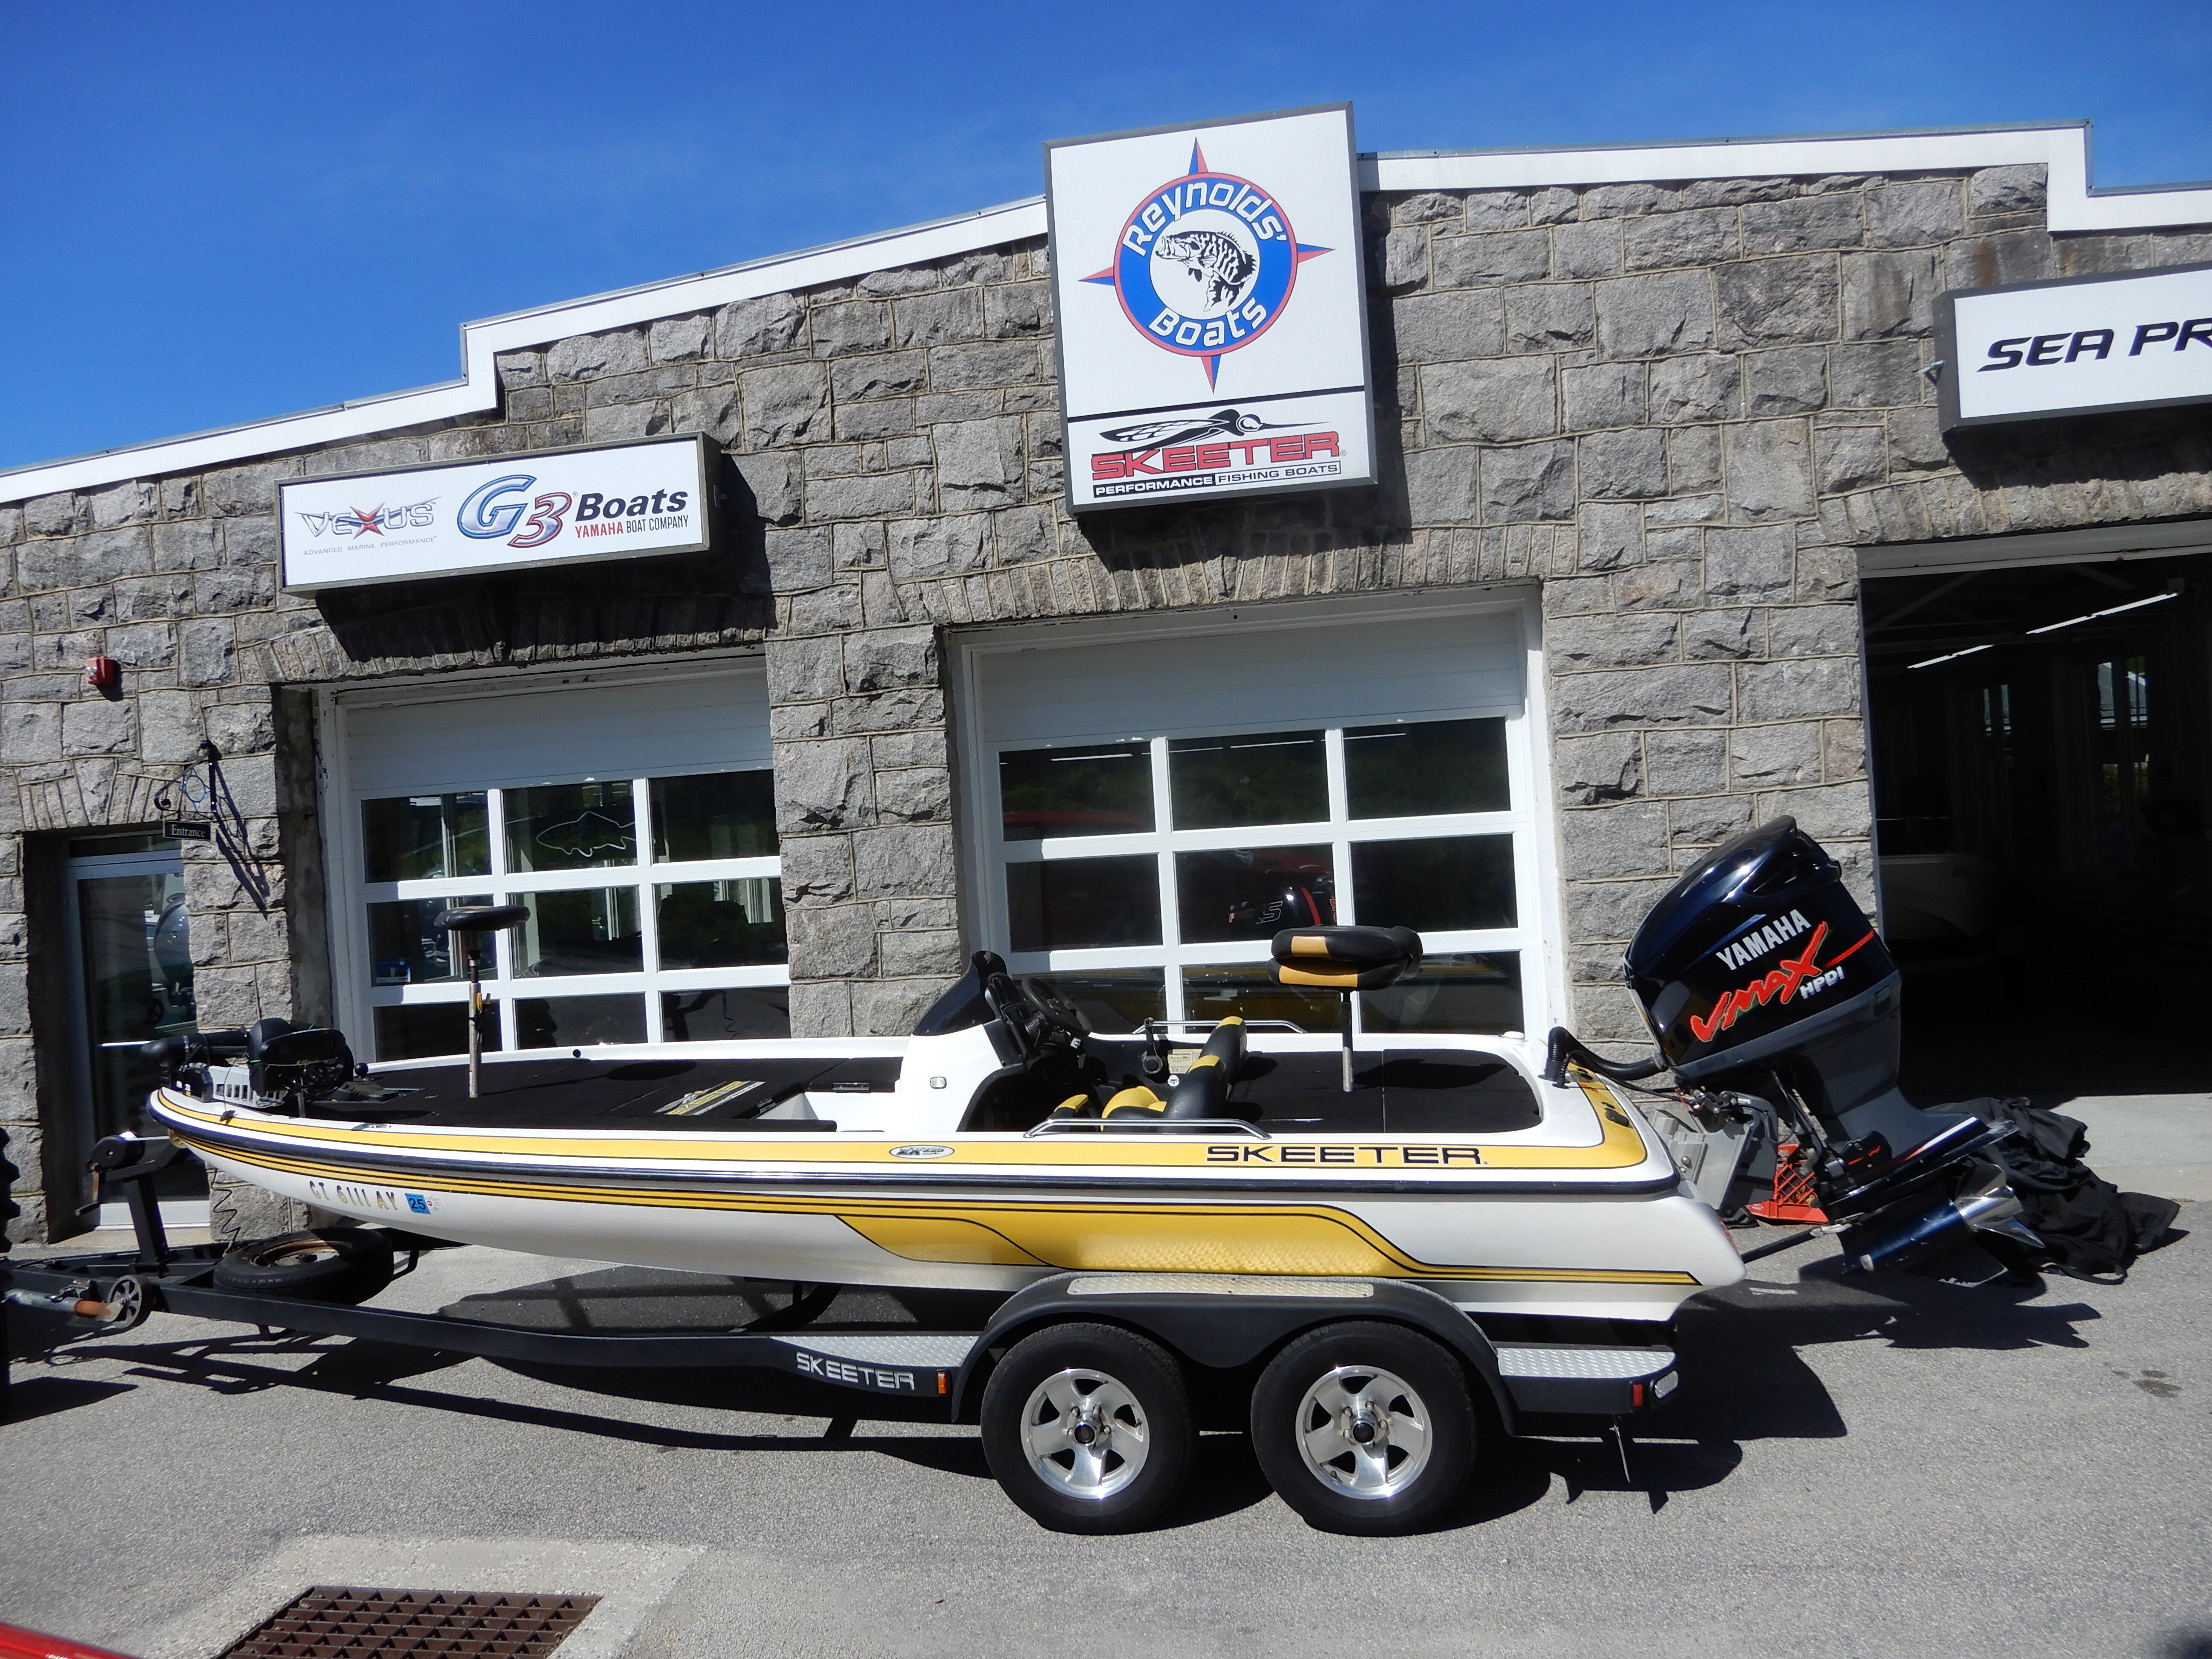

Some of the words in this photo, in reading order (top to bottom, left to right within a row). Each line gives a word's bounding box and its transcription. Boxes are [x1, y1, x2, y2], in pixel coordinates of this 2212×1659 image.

[1122, 181, 1288, 257] Reynolds'
[1148, 296, 1267, 347] Boats
[1976, 328, 2114, 373] SEA
[1091, 431, 1339, 480] SKEETER
[1095, 476, 1213, 495] PERFORMANCE
[1218, 470, 1279, 483] FISHING
[1285, 463, 1338, 476] BOATS
[300, 502, 435, 539] VEXUS
[457, 474, 572, 548] G3
[575, 488, 689, 522] Boats
[575, 521, 624, 538] YAMAHA
[626, 518, 646, 533] BOAT
[649, 515, 690, 530] COMPANY
[303, 547, 343, 556] ADVANCED
[347, 543, 376, 551] MARINE
[380, 536, 435, 548] PERFORMANCE
[171, 824, 206, 837] Entrance
[1715, 909, 1812, 971] YAMAHA
[1799, 966, 1845, 1000] HPDI
[1206, 1146, 1481, 1164] SKEETER
[309, 1180, 330, 1200] CT
[376, 1190, 398, 1211] AY
[408, 1197, 426, 1210] 25
[796, 1351, 915, 1391] SKEETER
